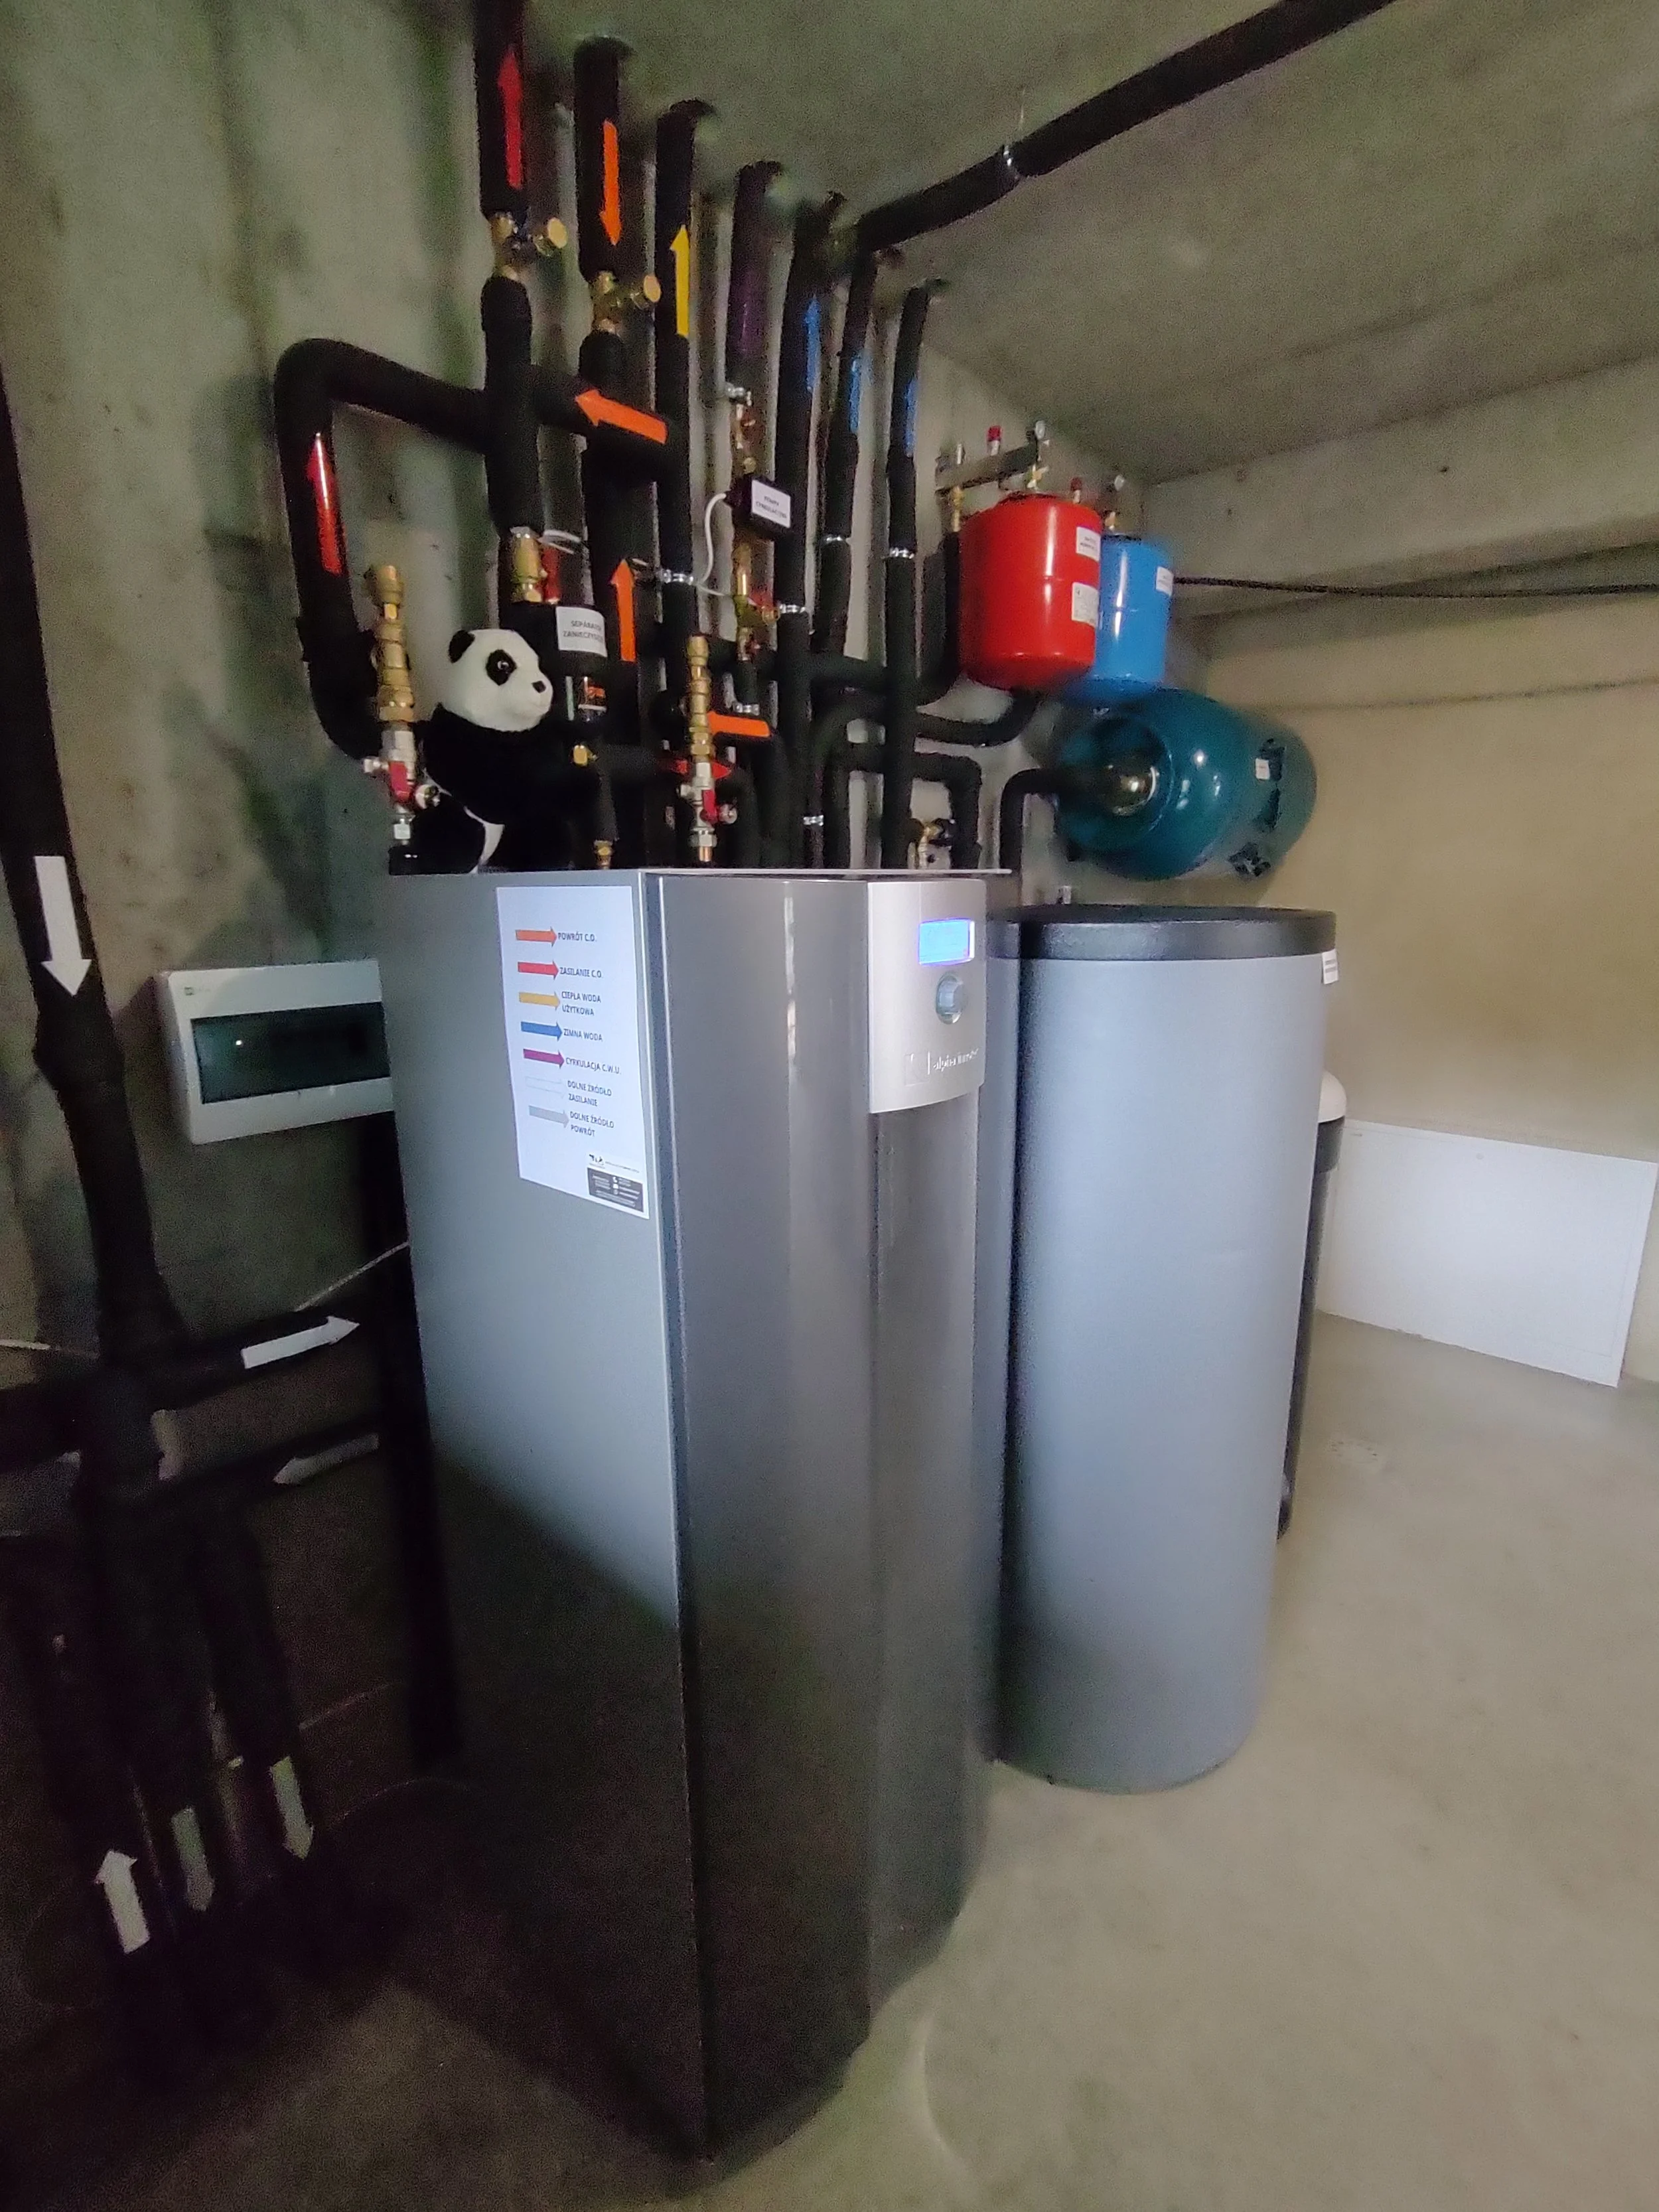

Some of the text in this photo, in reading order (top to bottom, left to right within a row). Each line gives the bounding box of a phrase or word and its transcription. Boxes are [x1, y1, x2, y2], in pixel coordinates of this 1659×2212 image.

[557, 931, 583, 941] POWRÓT
[559, 967, 590, 977] ZASILANIE
[582, 994, 601, 1003] WODA
[563, 1029, 603, 1041] ZIMNA WODA
[567, 1080, 587, 1091] DOLNE
[568, 1093, 598, 1106] ZASILANIE
[570, 1111, 589, 1122] DOLNE
[571, 1124, 595, 1138] POWRÓT
